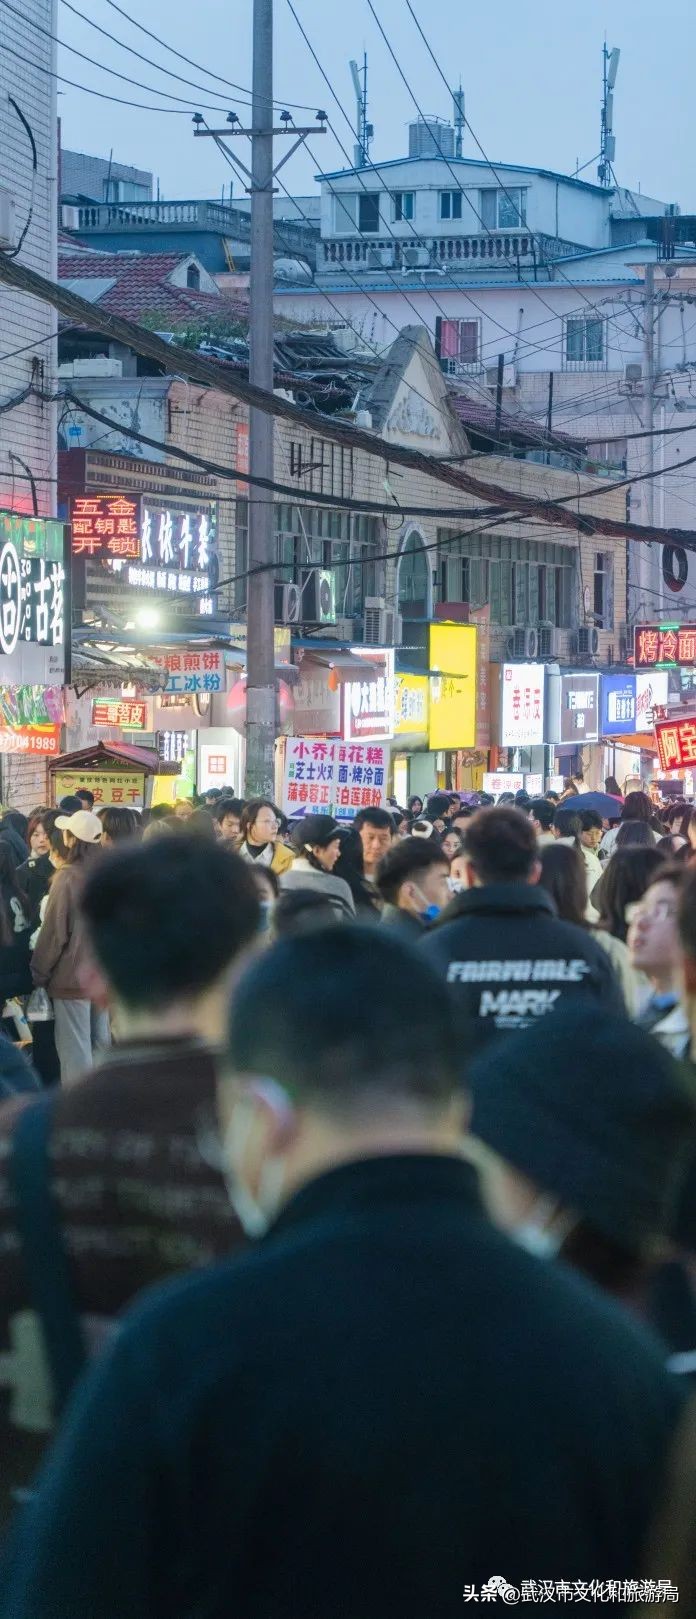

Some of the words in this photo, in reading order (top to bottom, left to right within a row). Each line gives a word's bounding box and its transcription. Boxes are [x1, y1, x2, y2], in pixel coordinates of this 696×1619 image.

[73, 498, 137, 516] 五金
[72, 518, 137, 534] 配钥匙
[72, 536, 136, 554] 开锁
[34, 558, 65, 646] 古茗
[638, 629, 696, 663] 烤冷面
[661, 723, 696, 767] 阿宝
